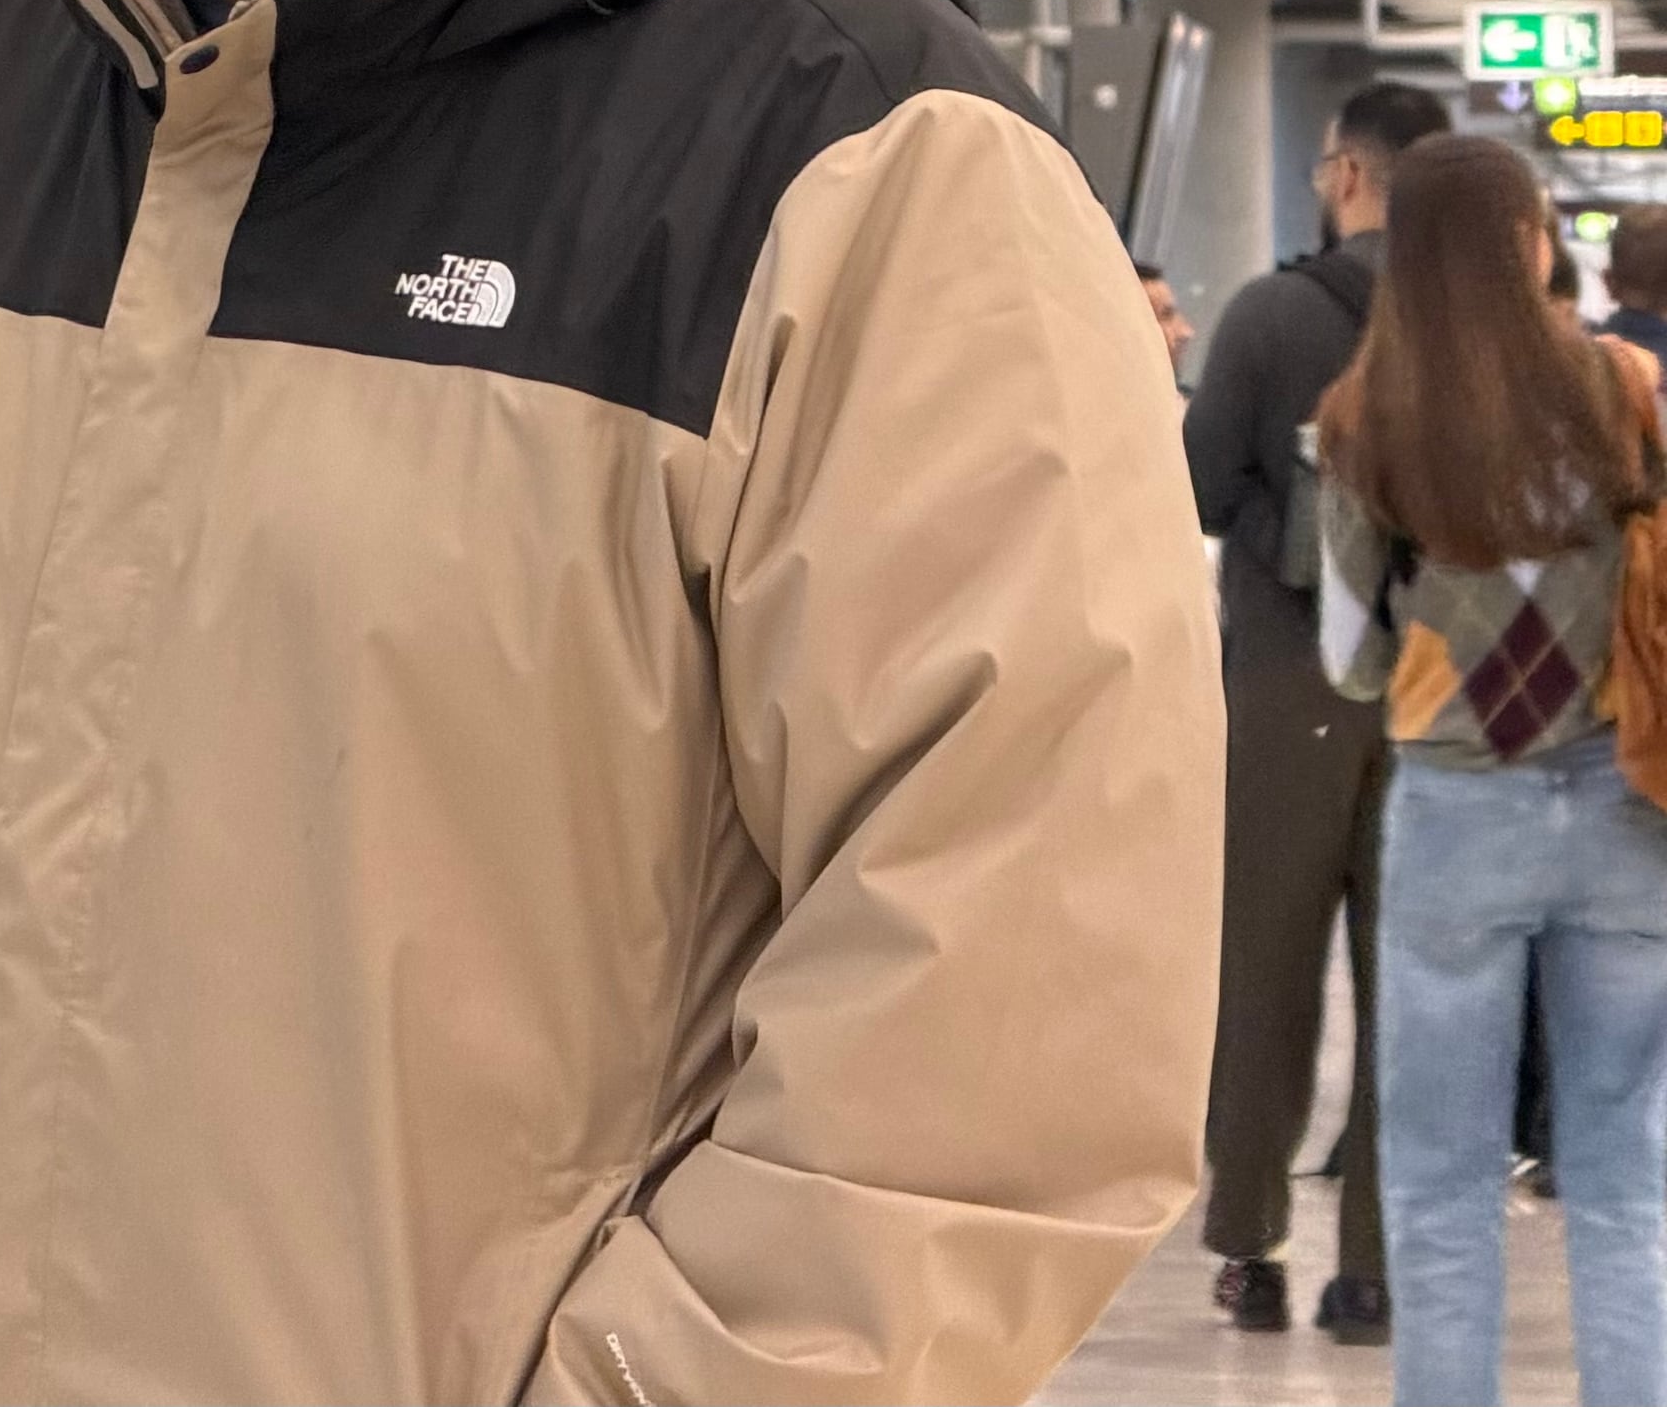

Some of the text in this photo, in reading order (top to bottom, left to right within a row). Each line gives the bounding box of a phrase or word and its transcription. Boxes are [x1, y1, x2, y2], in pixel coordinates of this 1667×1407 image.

[442, 254, 490, 281] THE
[394, 273, 480, 303] NORTH
[407, 296, 473, 326] FACE
